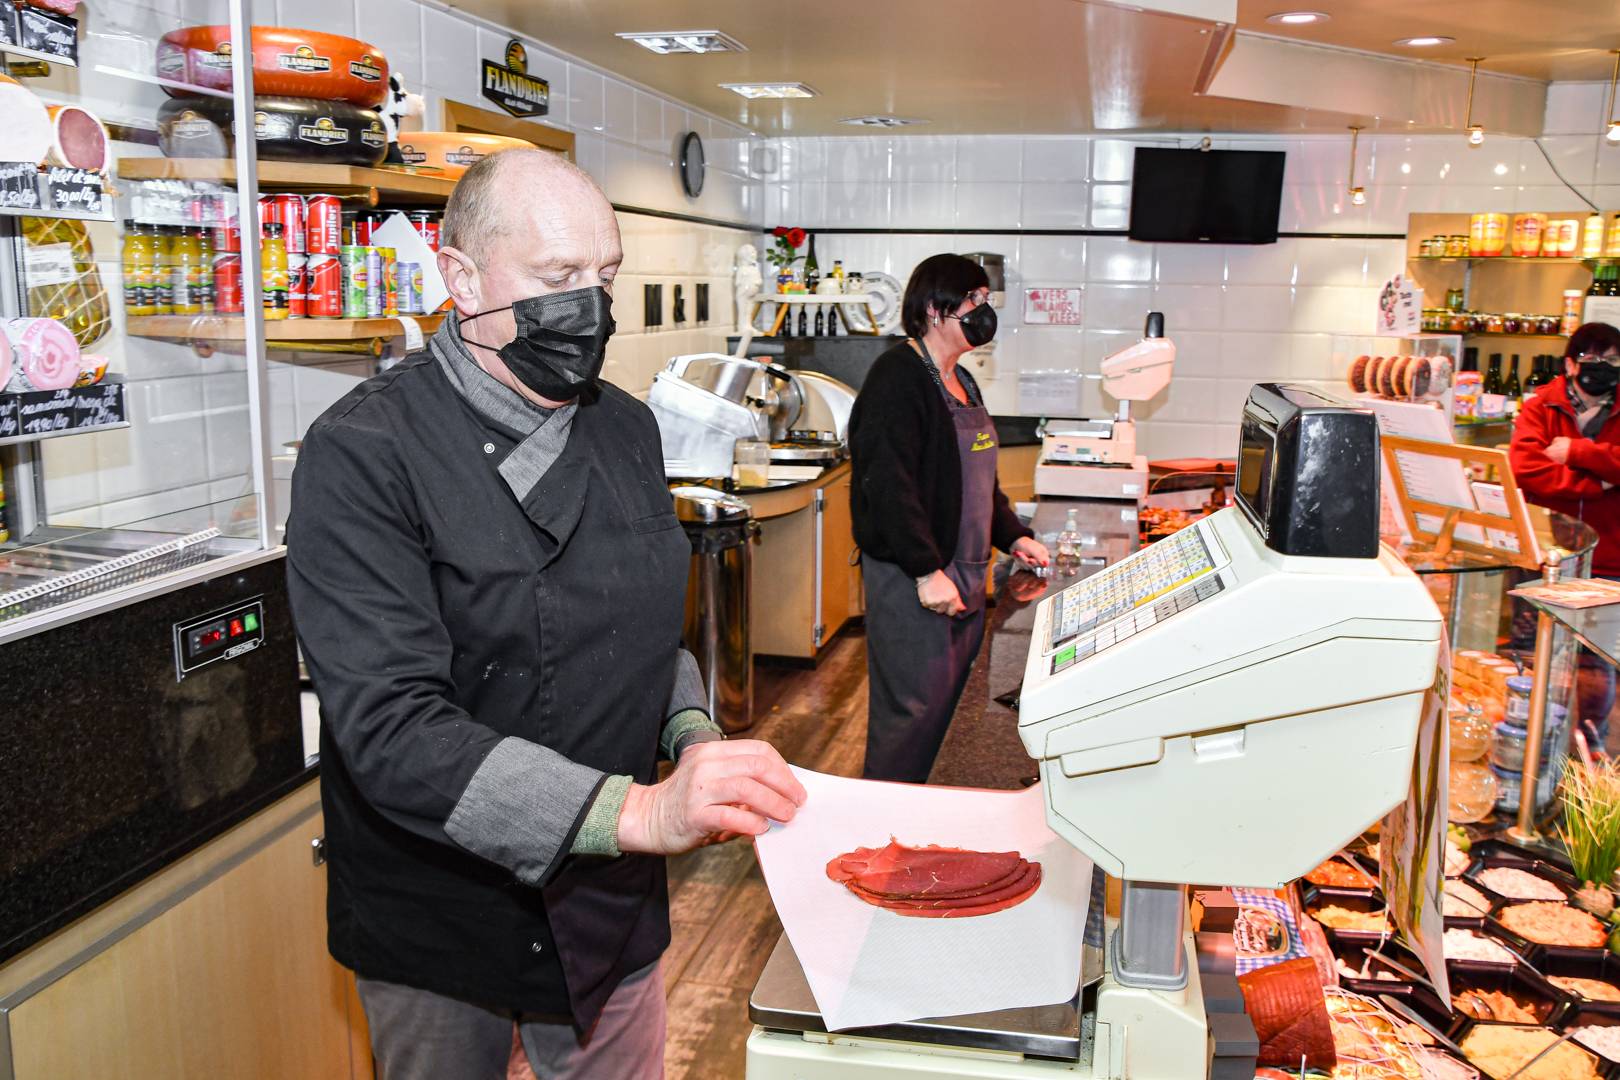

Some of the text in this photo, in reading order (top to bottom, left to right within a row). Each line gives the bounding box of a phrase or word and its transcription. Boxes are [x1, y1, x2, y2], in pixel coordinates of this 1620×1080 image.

[486, 65, 549, 105] FLANDRIEN
[301, 127, 347, 139] FLANDRIEN
[326, 204, 338, 247] Jupiler
[1048, 311, 1080, 324] VLEES
